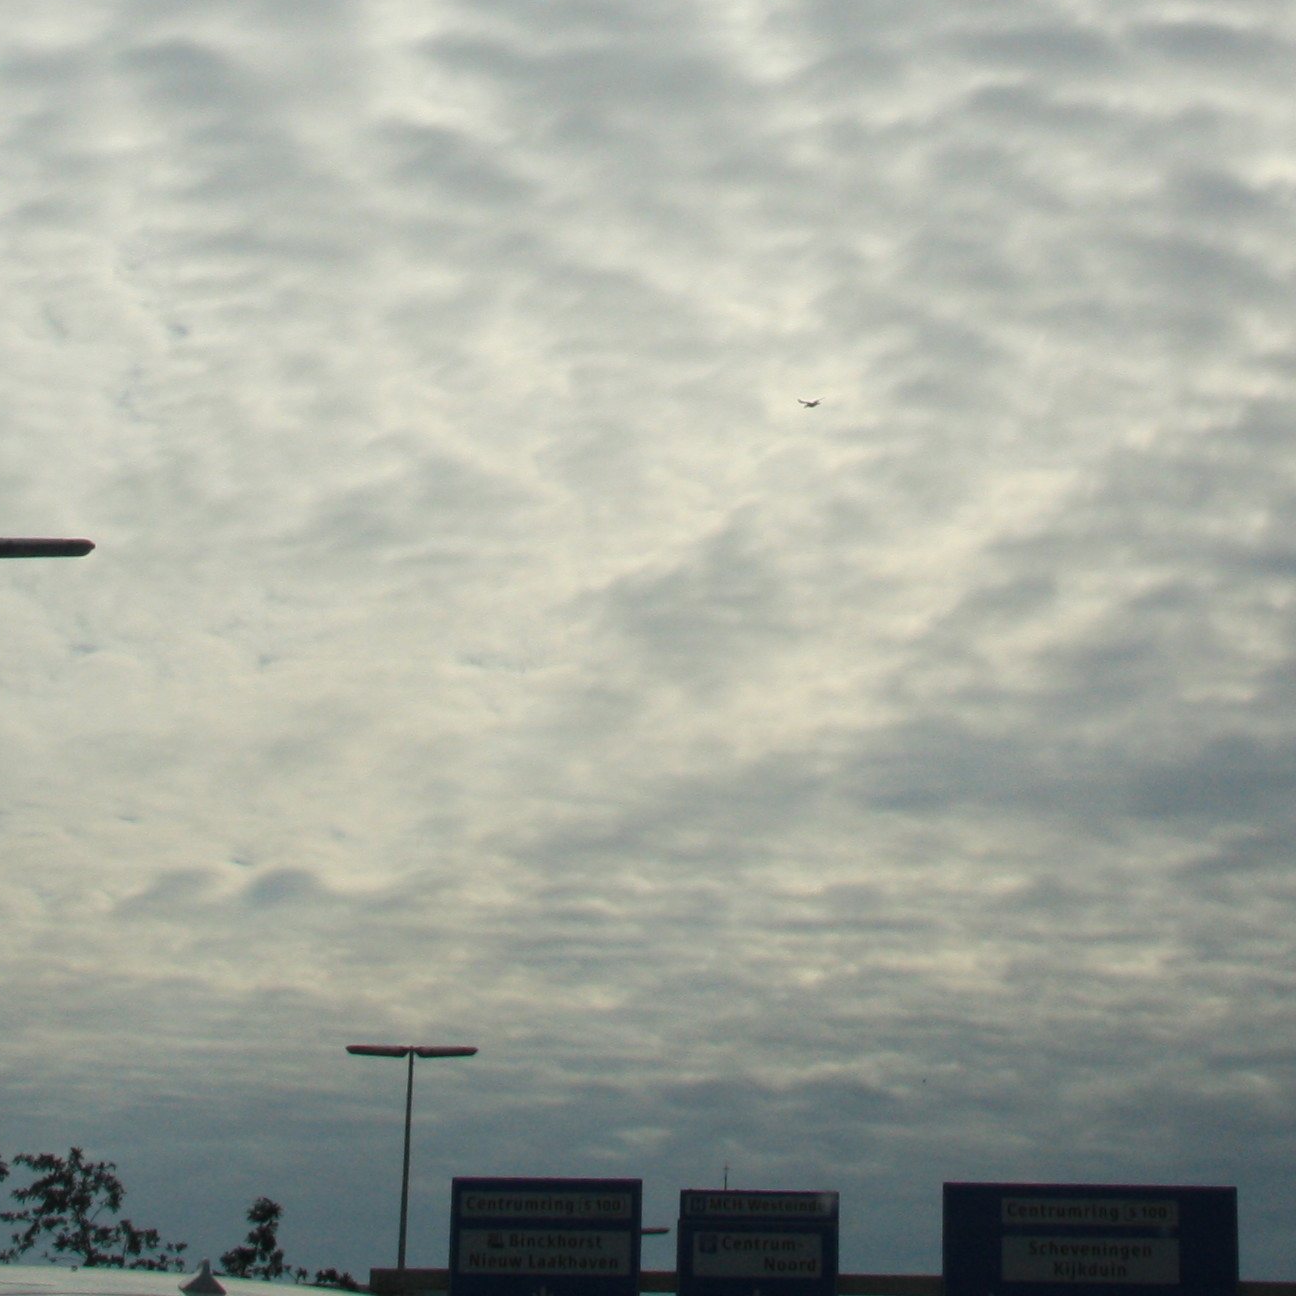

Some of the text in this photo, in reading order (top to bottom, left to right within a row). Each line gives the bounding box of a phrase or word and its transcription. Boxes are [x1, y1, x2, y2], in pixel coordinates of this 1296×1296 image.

[466, 1195, 574, 1213] Centrumring
[710, 1196, 742, 1211] MCH
[1007, 1203, 1119, 1222] Centrumring
[509, 1232, 602, 1249] Binckhorst
[722, 1235, 804, 1251] Centrum-
[1029, 1241, 1153, 1259] Scheveningen
[469, 1253, 618, 1270] Nieuw Laakhaven
[764, 1256, 816, 1272] Noord
[1054, 1262, 1127, 1279] Kijkduin
